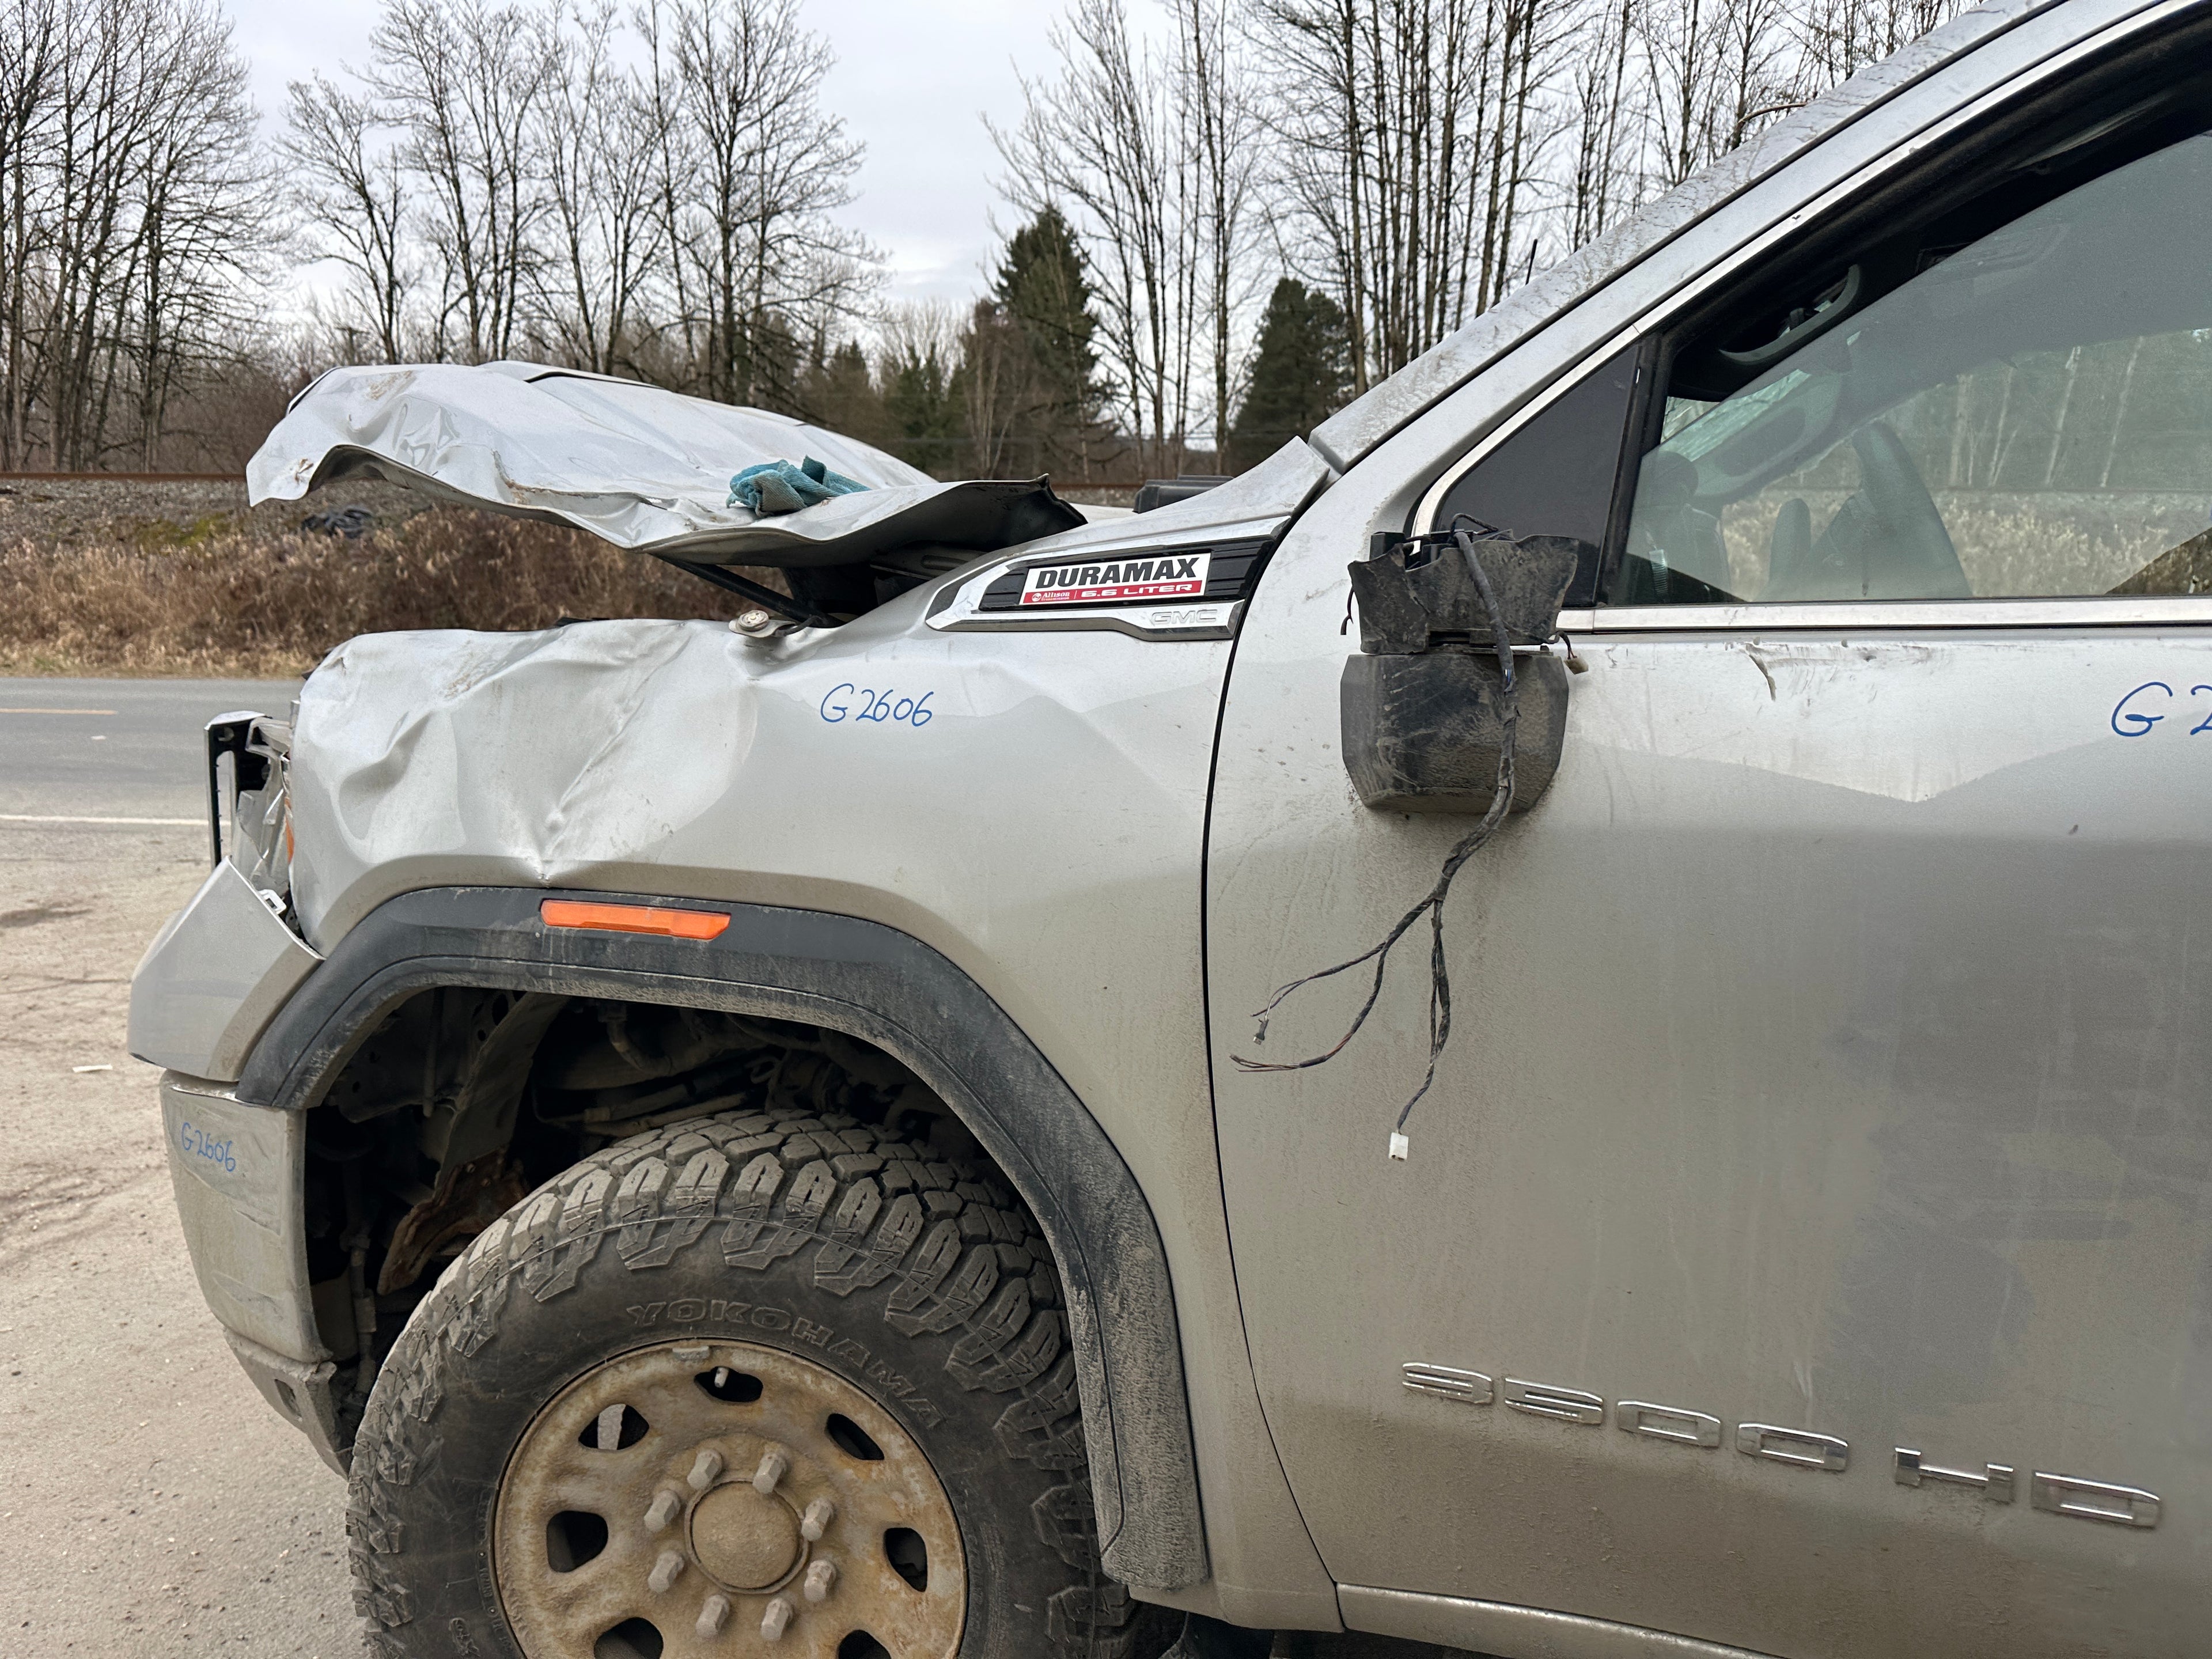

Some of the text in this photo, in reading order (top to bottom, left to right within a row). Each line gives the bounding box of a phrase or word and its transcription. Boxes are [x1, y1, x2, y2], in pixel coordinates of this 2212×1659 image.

[1036, 557, 1200, 589] DURAMAX
[1081, 584, 1193, 597] 6.6 LITER
[1152, 609, 1218, 625] GMC
[820, 683, 934, 726] G2606
[181, 1122, 236, 1172] G2606
[626, 1298, 946, 1429] YOKOHAMA
[1402, 1361, 2161, 1531] 3500 HD
